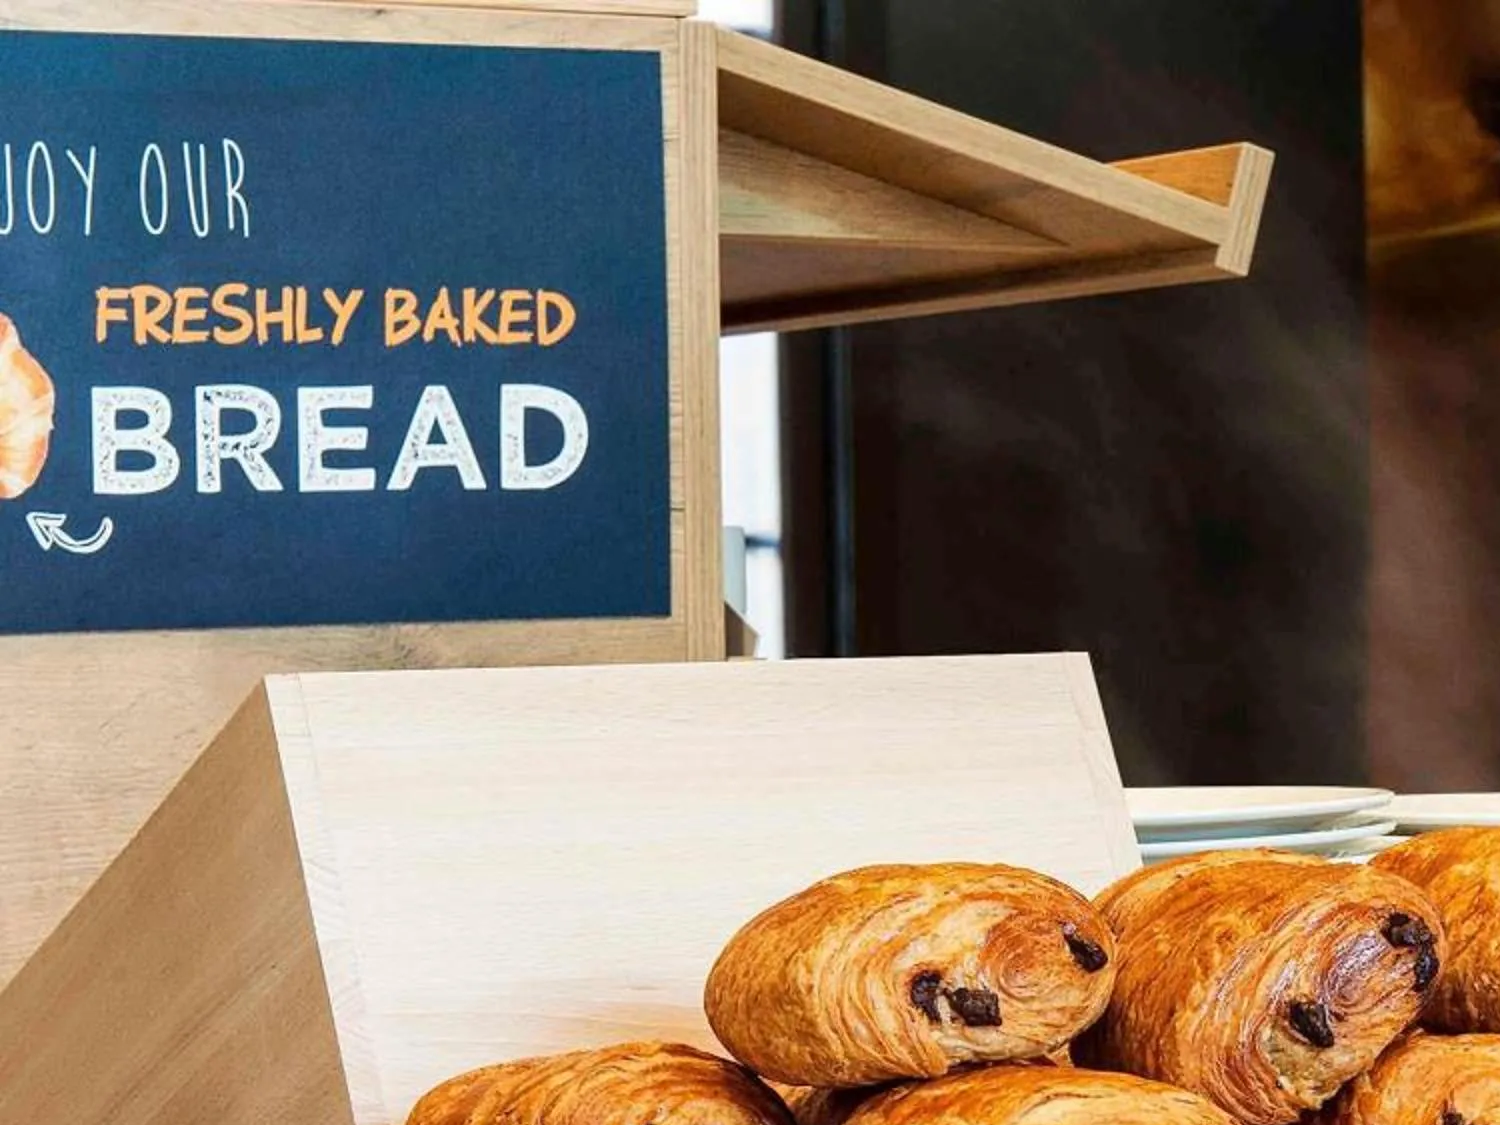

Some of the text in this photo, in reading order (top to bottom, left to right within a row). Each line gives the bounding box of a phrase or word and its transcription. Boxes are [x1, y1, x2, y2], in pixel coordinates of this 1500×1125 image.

[139, 138, 249, 238] OUR
[95, 283, 576, 347] FRESHLY BAKED
[91, 383, 589, 495] BREAD
